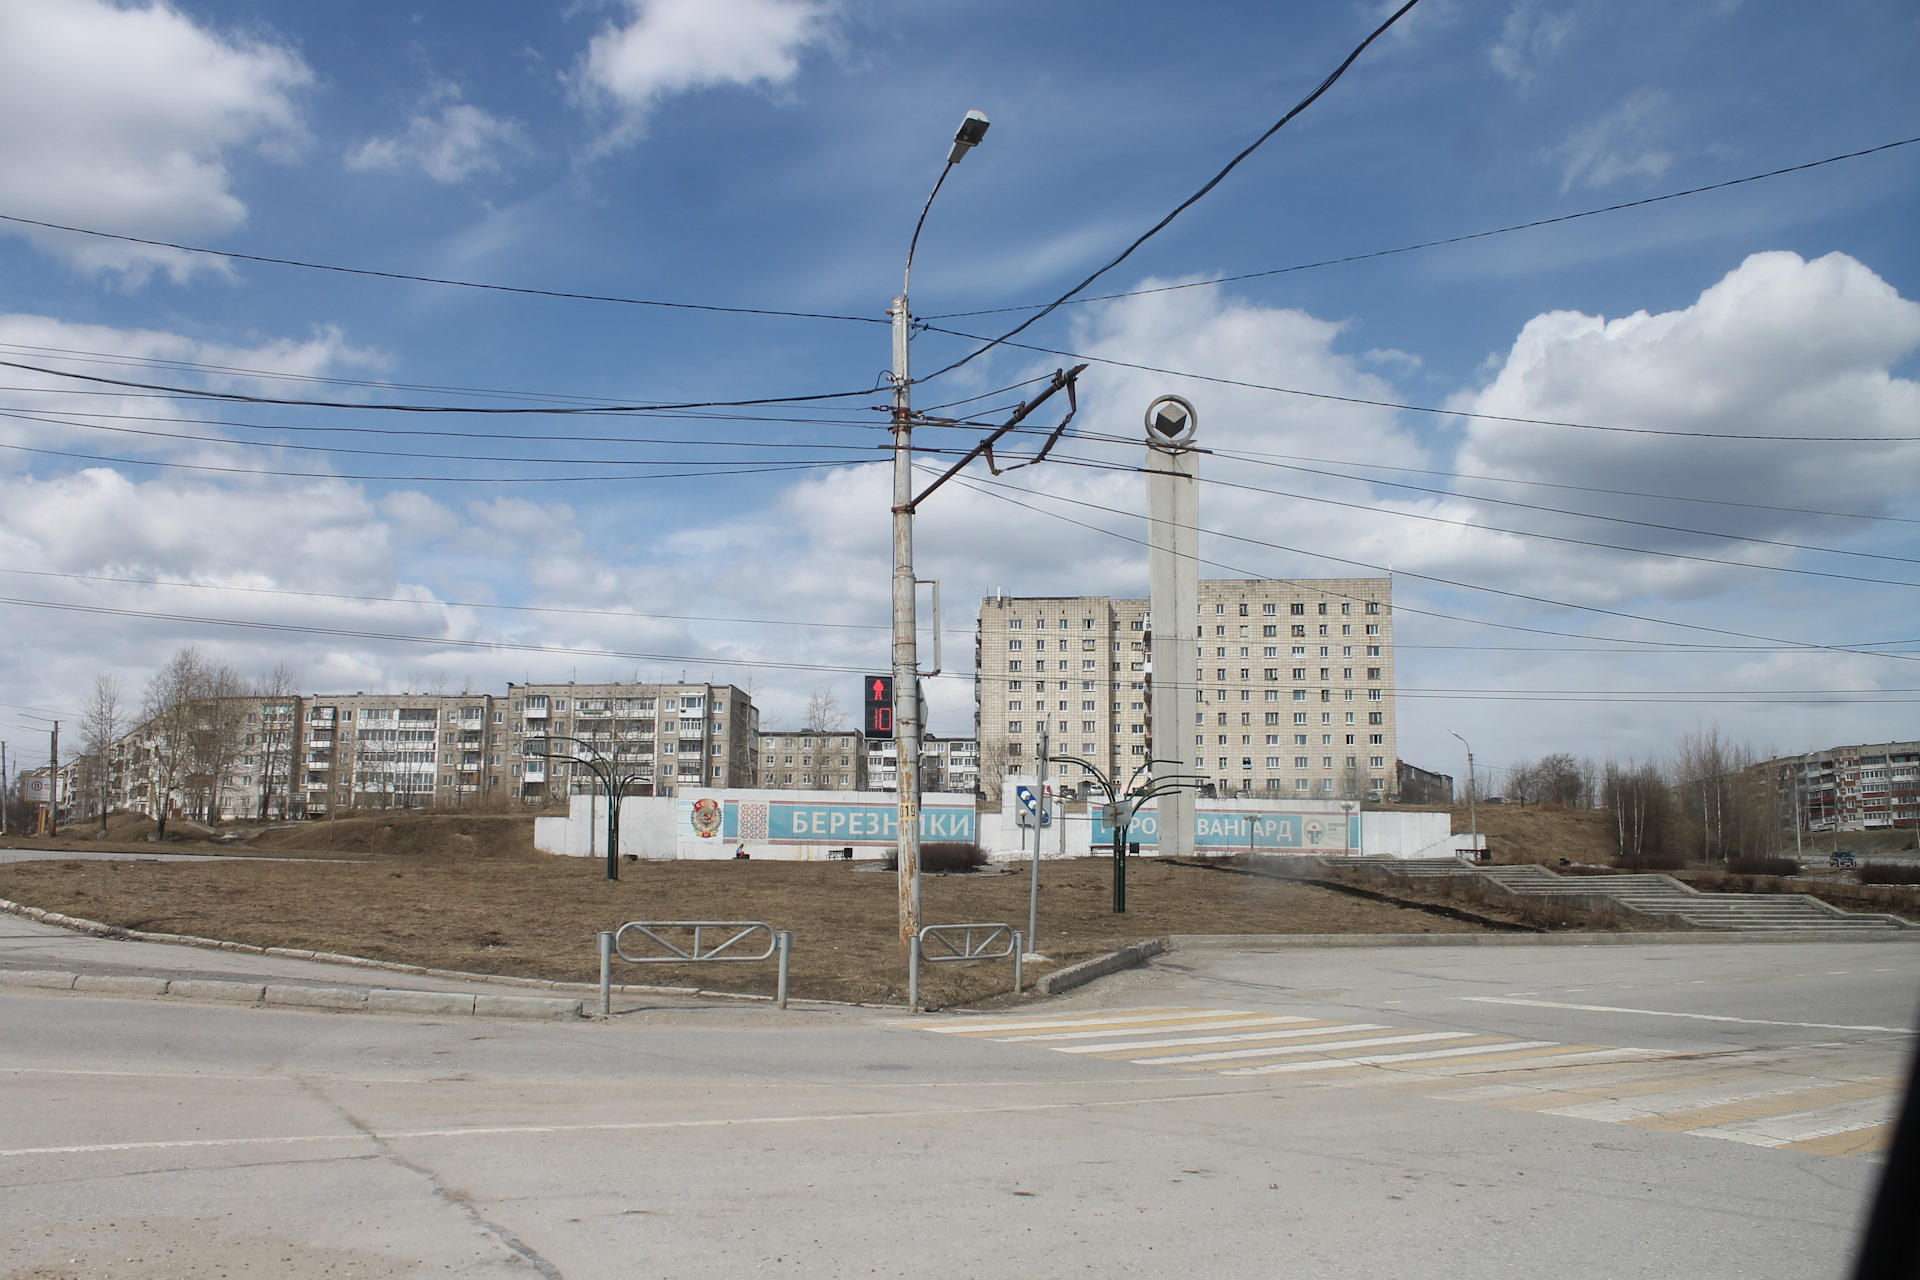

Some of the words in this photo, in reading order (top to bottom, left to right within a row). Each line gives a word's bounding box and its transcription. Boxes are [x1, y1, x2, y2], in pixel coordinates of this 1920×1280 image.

[875, 707, 892, 730] 10
[900, 805, 916, 817] 619
[1195, 818, 1293, 842] ВАНГАРД
